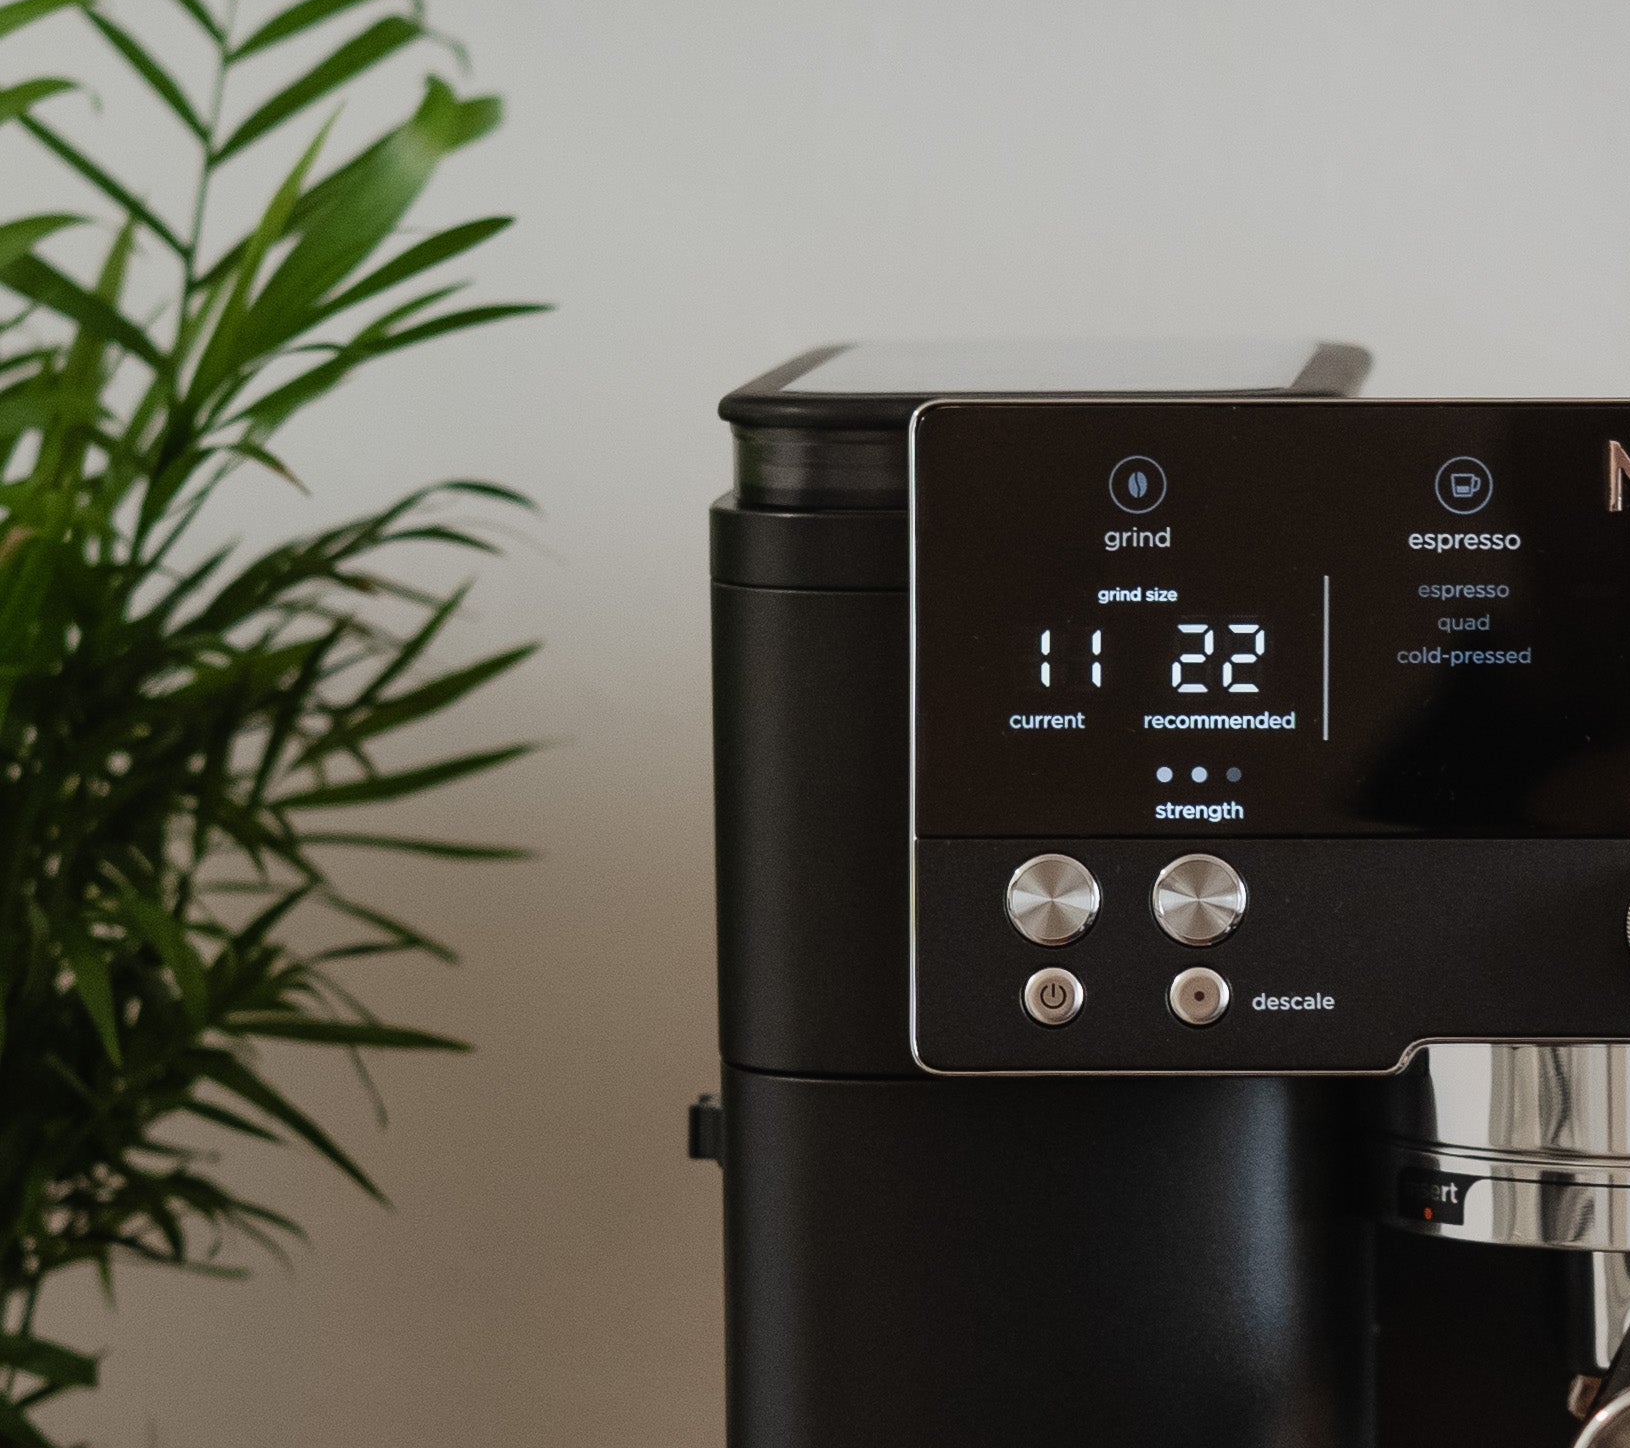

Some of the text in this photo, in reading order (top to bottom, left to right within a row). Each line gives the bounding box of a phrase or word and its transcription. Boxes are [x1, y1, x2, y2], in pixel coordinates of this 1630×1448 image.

[1104, 525, 1171, 552] grind
[1408, 532, 1521, 554] espresso
[1097, 585, 1178, 605] grind size
[1418, 583, 1510, 601] espresso
[1437, 612, 1490, 634] quad
[1040, 628, 1102, 688] 11
[1171, 623, 1265, 693] 22
[1396, 645, 1532, 667] cold-pressed
[1009, 710, 1086, 729] current
[1144, 709, 1296, 730] recommended
[1155, 799, 1244, 823] strength
[1251, 991, 1335, 1011] descale
[1405, 1181, 1459, 1204] sert
